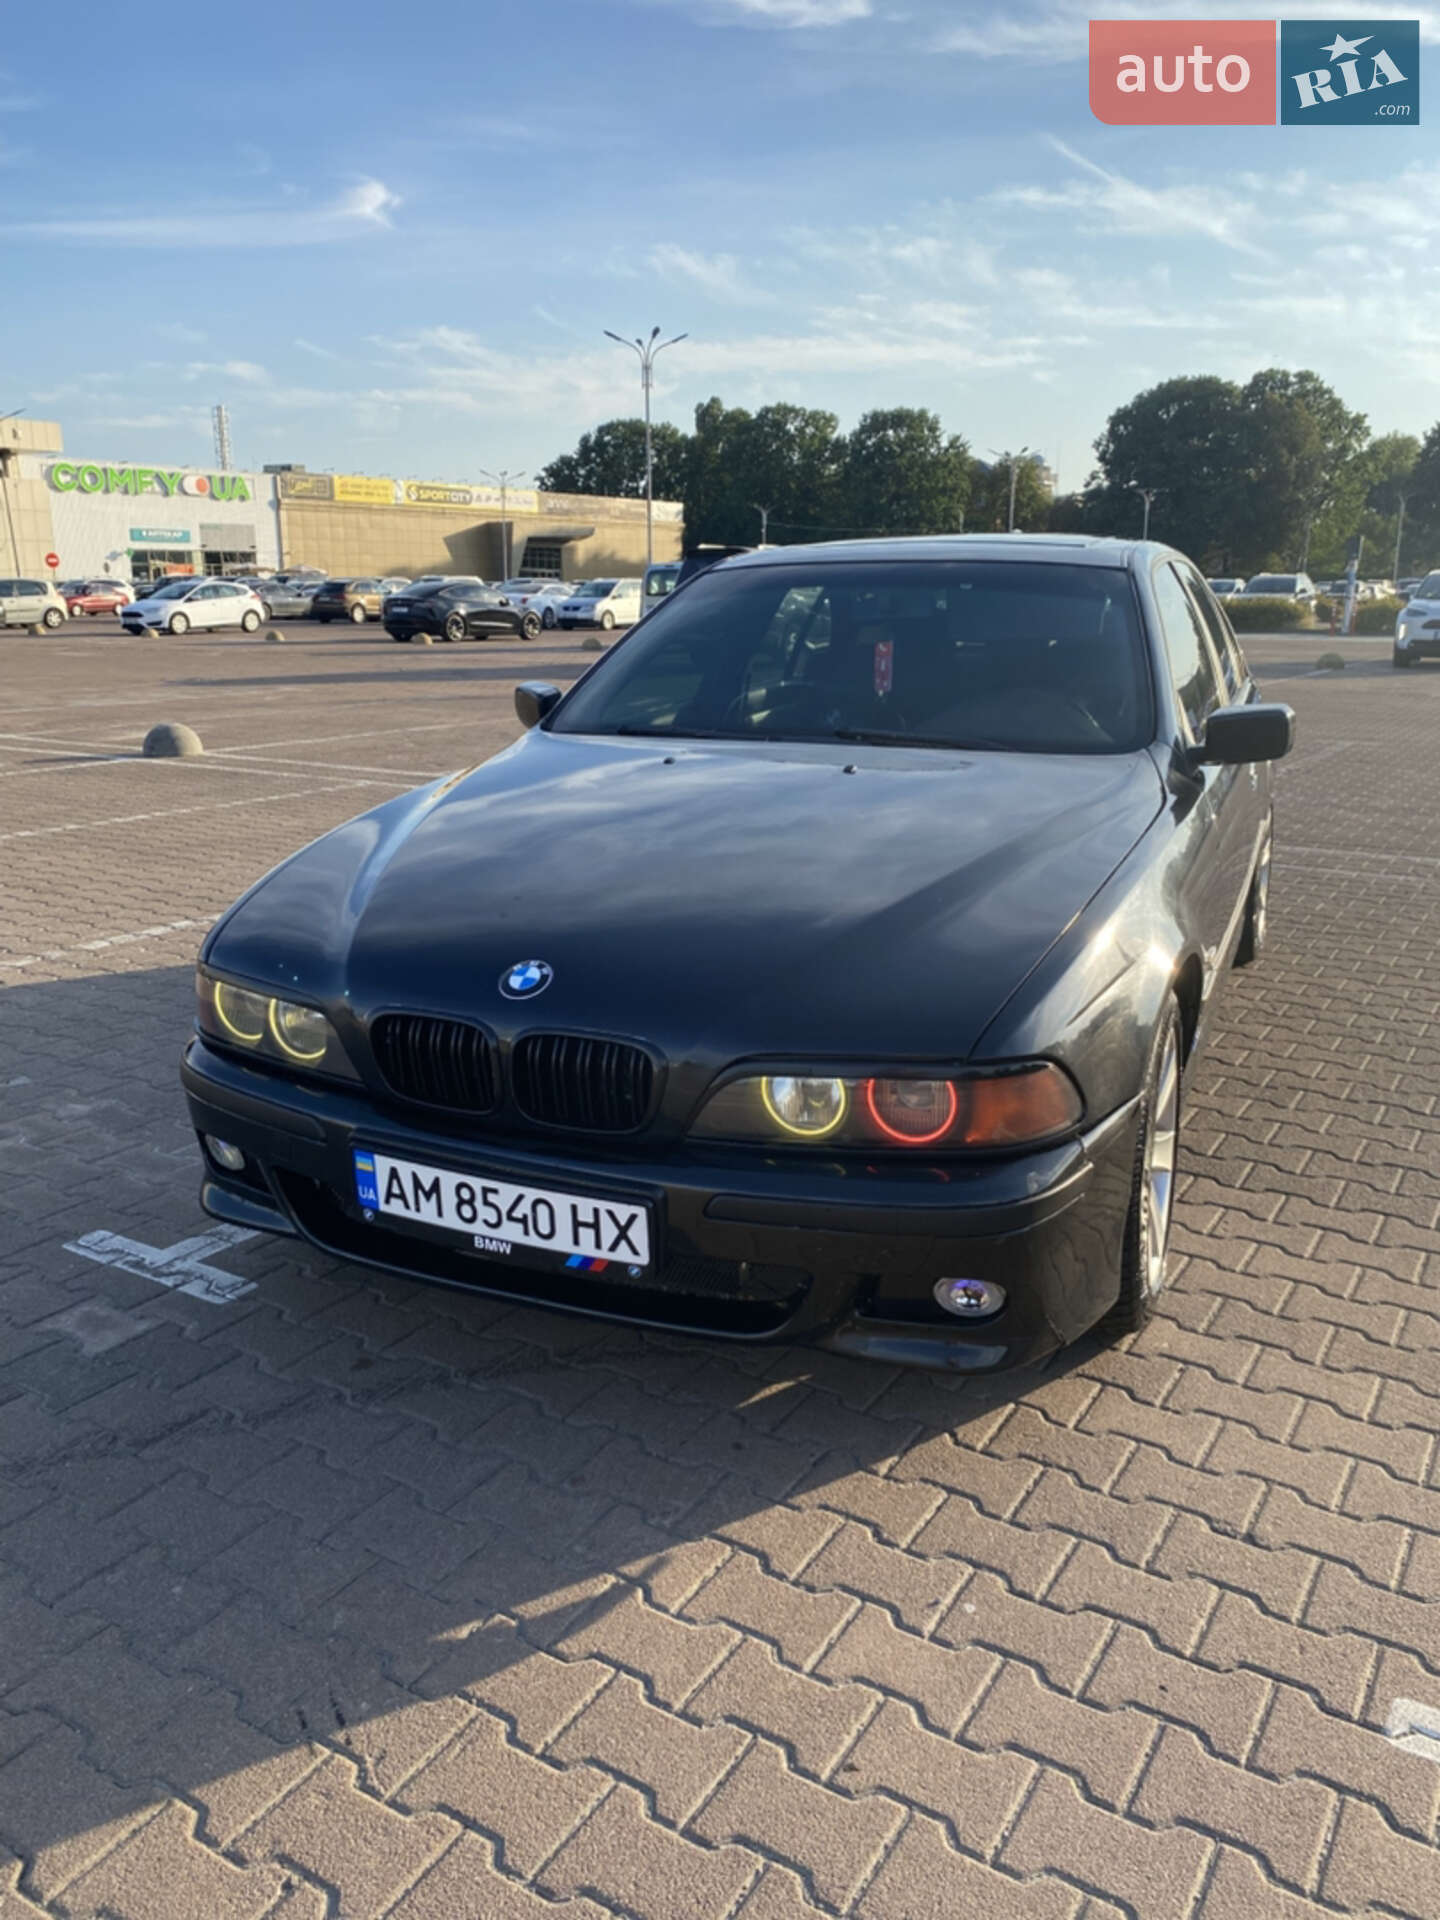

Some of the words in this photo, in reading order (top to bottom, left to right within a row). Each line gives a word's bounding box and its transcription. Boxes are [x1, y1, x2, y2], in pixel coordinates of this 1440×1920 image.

[52, 463, 182, 496] COMFY
[211, 475, 250, 500] UA
[359, 1185, 378, 1201] UA
[384, 1166, 444, 1219] AM
[455, 1181, 557, 1241] 8540
[570, 1203, 641, 1257] HX
[473, 1236, 513, 1255] BMW
